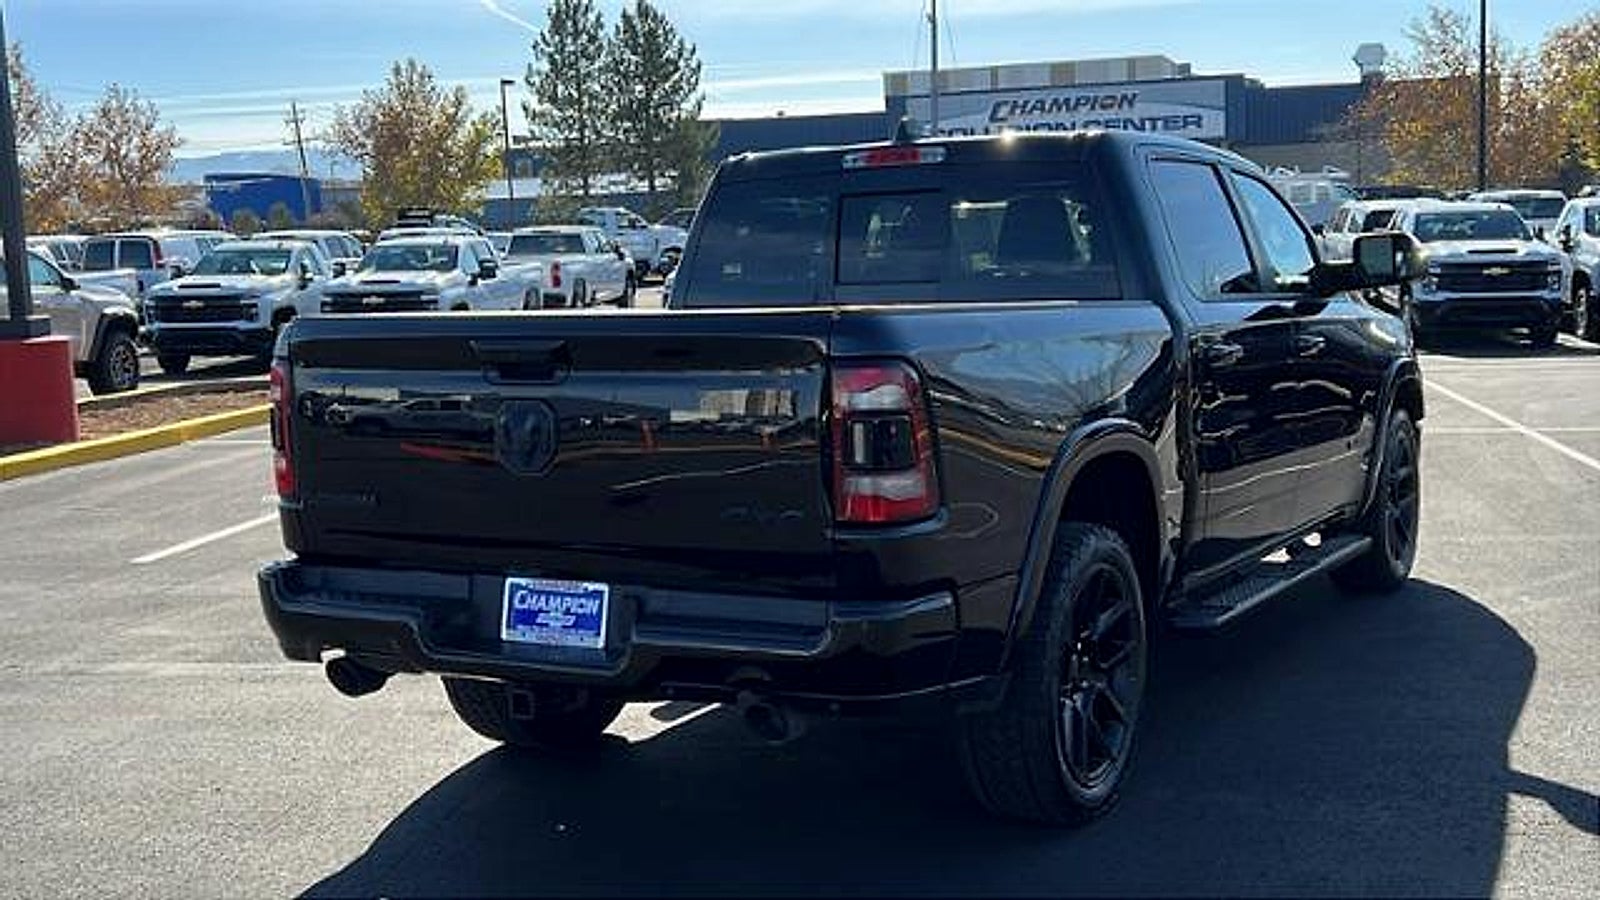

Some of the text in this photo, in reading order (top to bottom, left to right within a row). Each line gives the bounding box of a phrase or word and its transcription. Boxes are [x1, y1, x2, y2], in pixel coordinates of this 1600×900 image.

[989, 93, 1138, 123] CHAMPION
[1081, 114, 1203, 133] CENTER
[514, 590, 601, 615] CHAMPION
